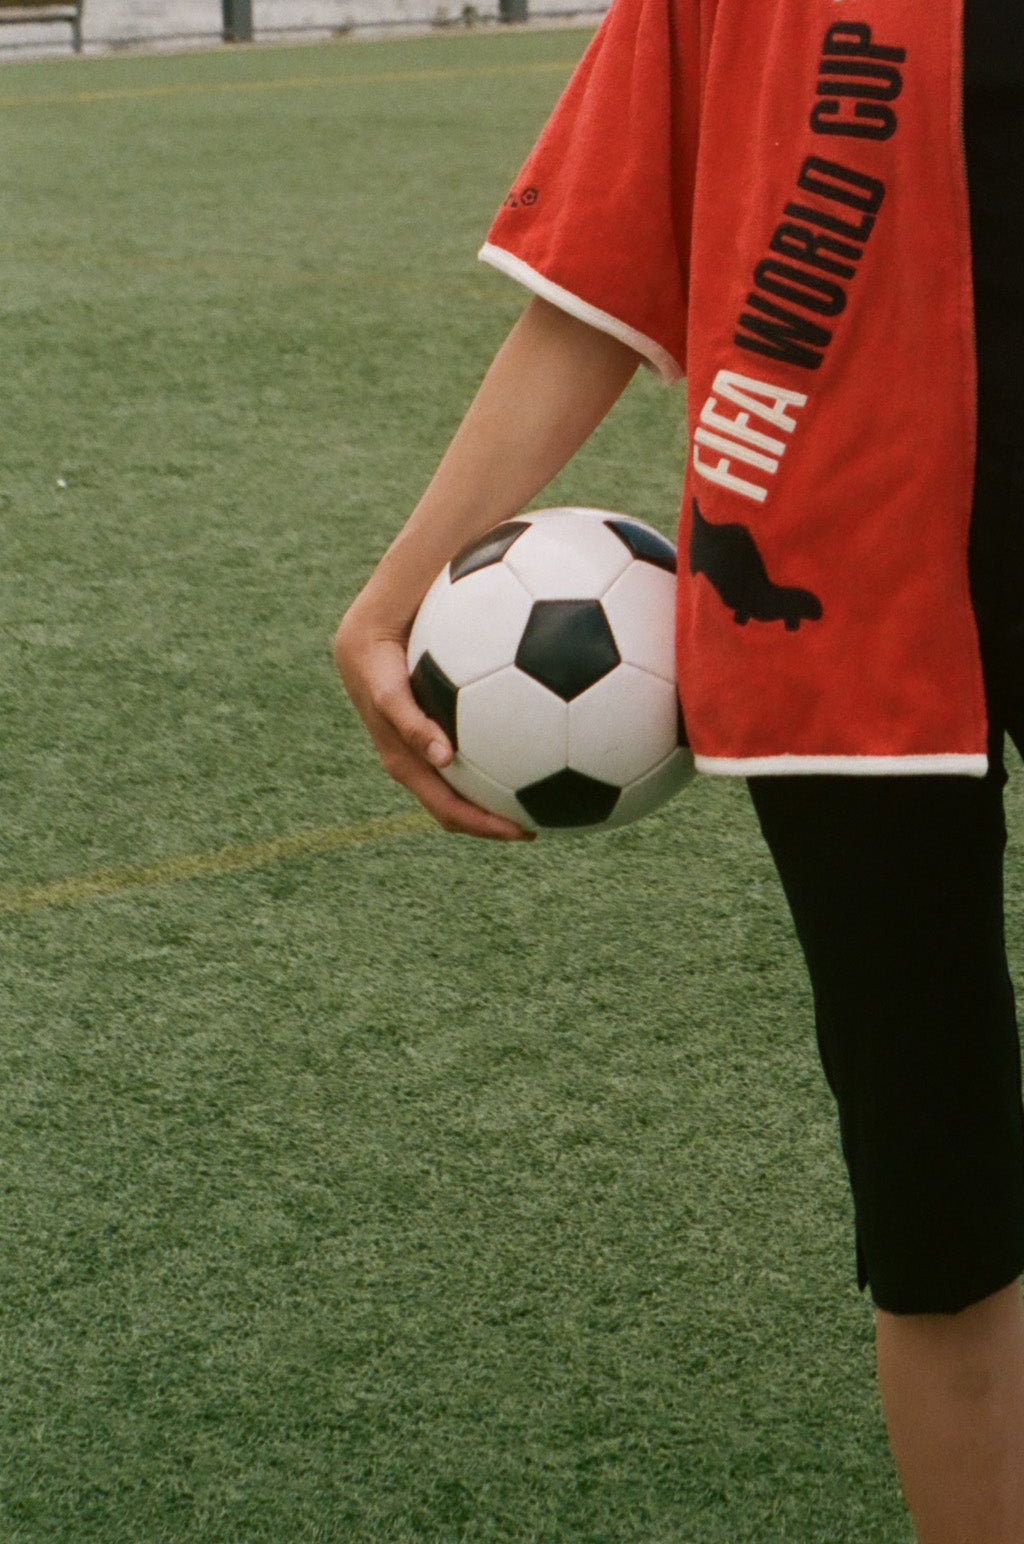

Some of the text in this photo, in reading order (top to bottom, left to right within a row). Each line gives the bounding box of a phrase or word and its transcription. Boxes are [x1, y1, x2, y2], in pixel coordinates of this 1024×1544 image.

[809, 20, 906, 141] CUP
[734, 156, 886, 370] WORLD
[693, 369, 808, 503] FIFA
